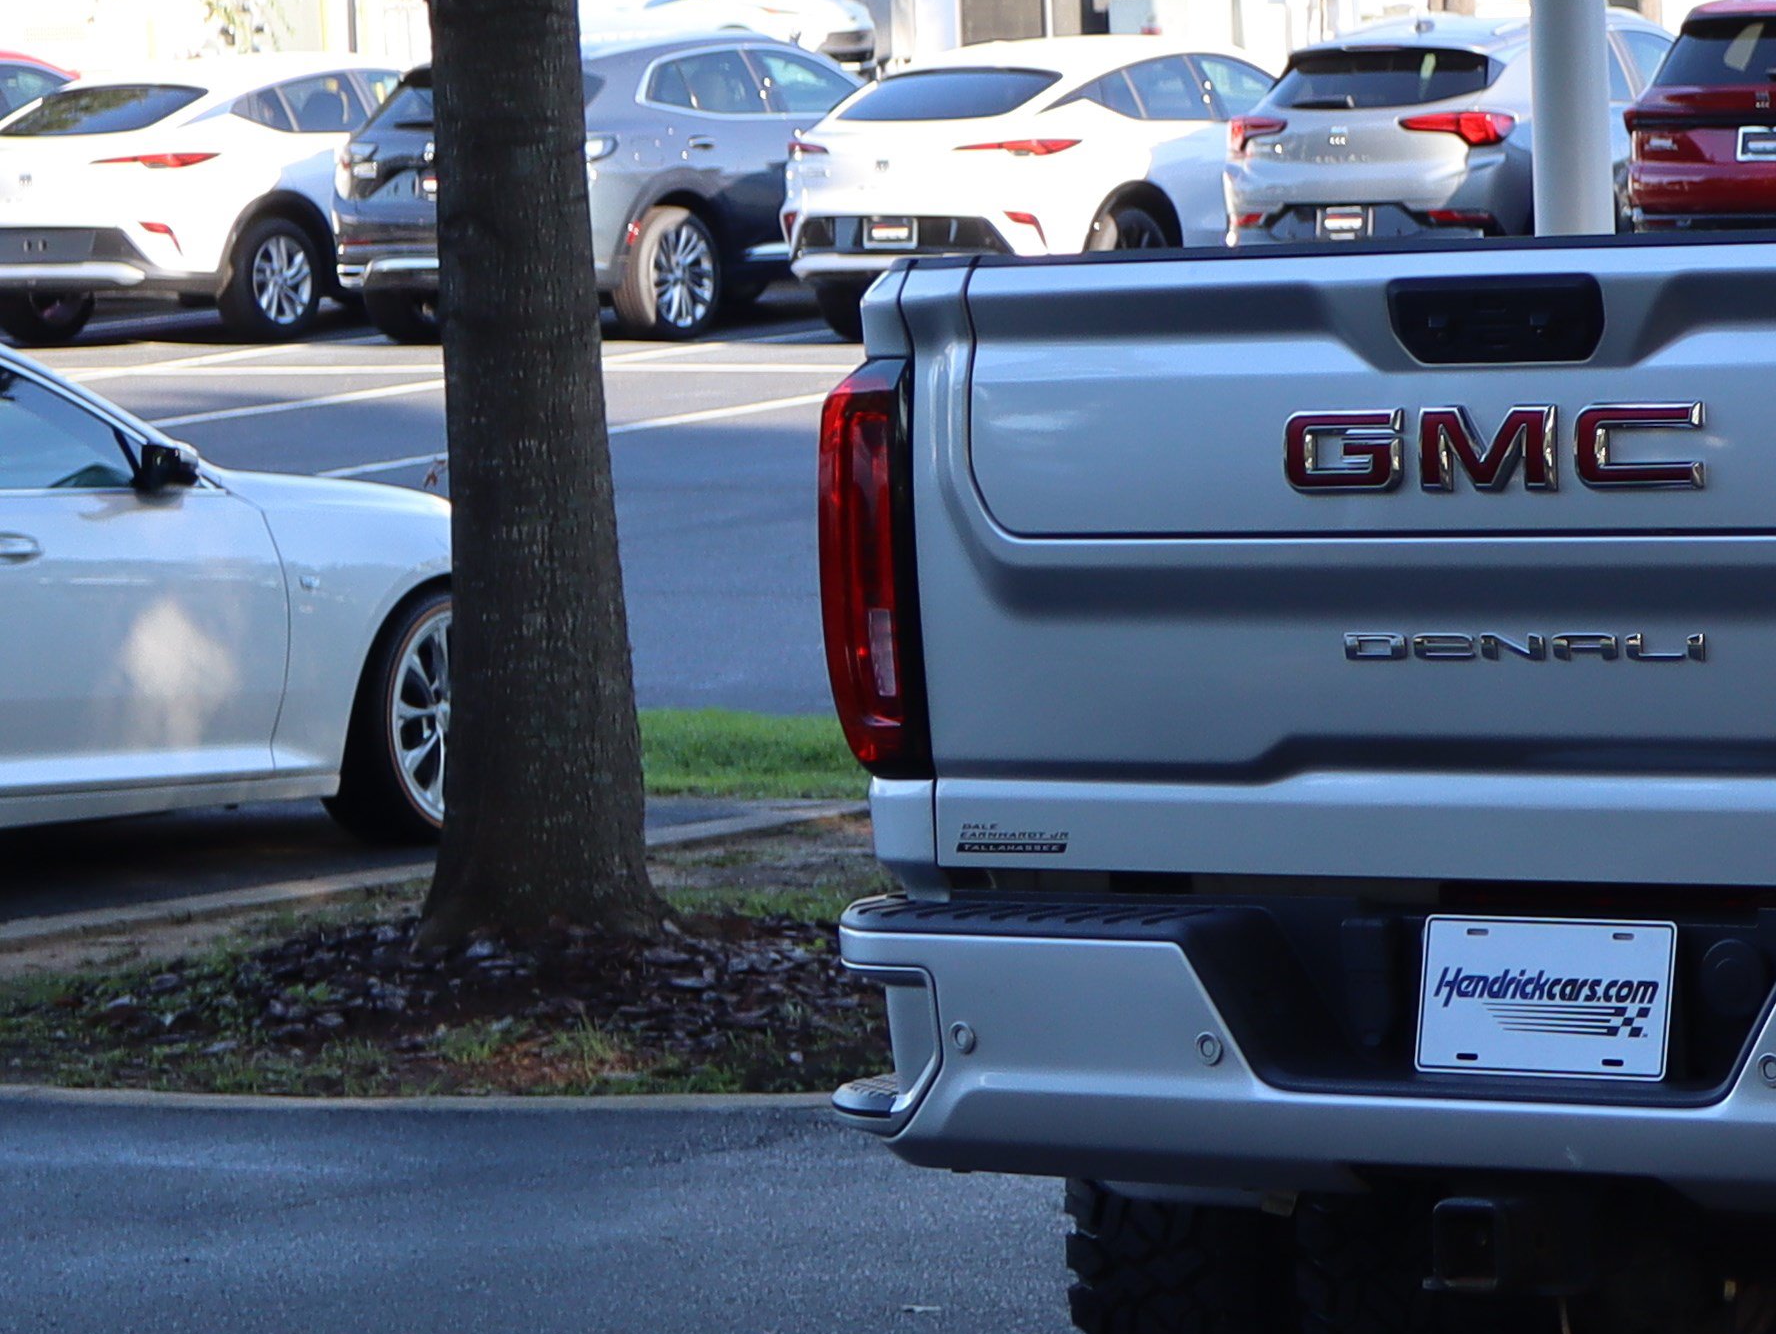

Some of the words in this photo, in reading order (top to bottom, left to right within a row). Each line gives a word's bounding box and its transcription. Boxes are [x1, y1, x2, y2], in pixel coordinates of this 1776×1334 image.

[1283, 400, 1706, 494] GMC
[1343, 631, 1706, 661] DENALI
[961, 822, 999, 831] DALE
[963, 843, 1061, 852] TALLAHASSEE
[1432, 966, 1660, 1008] Hendrickcars.com
